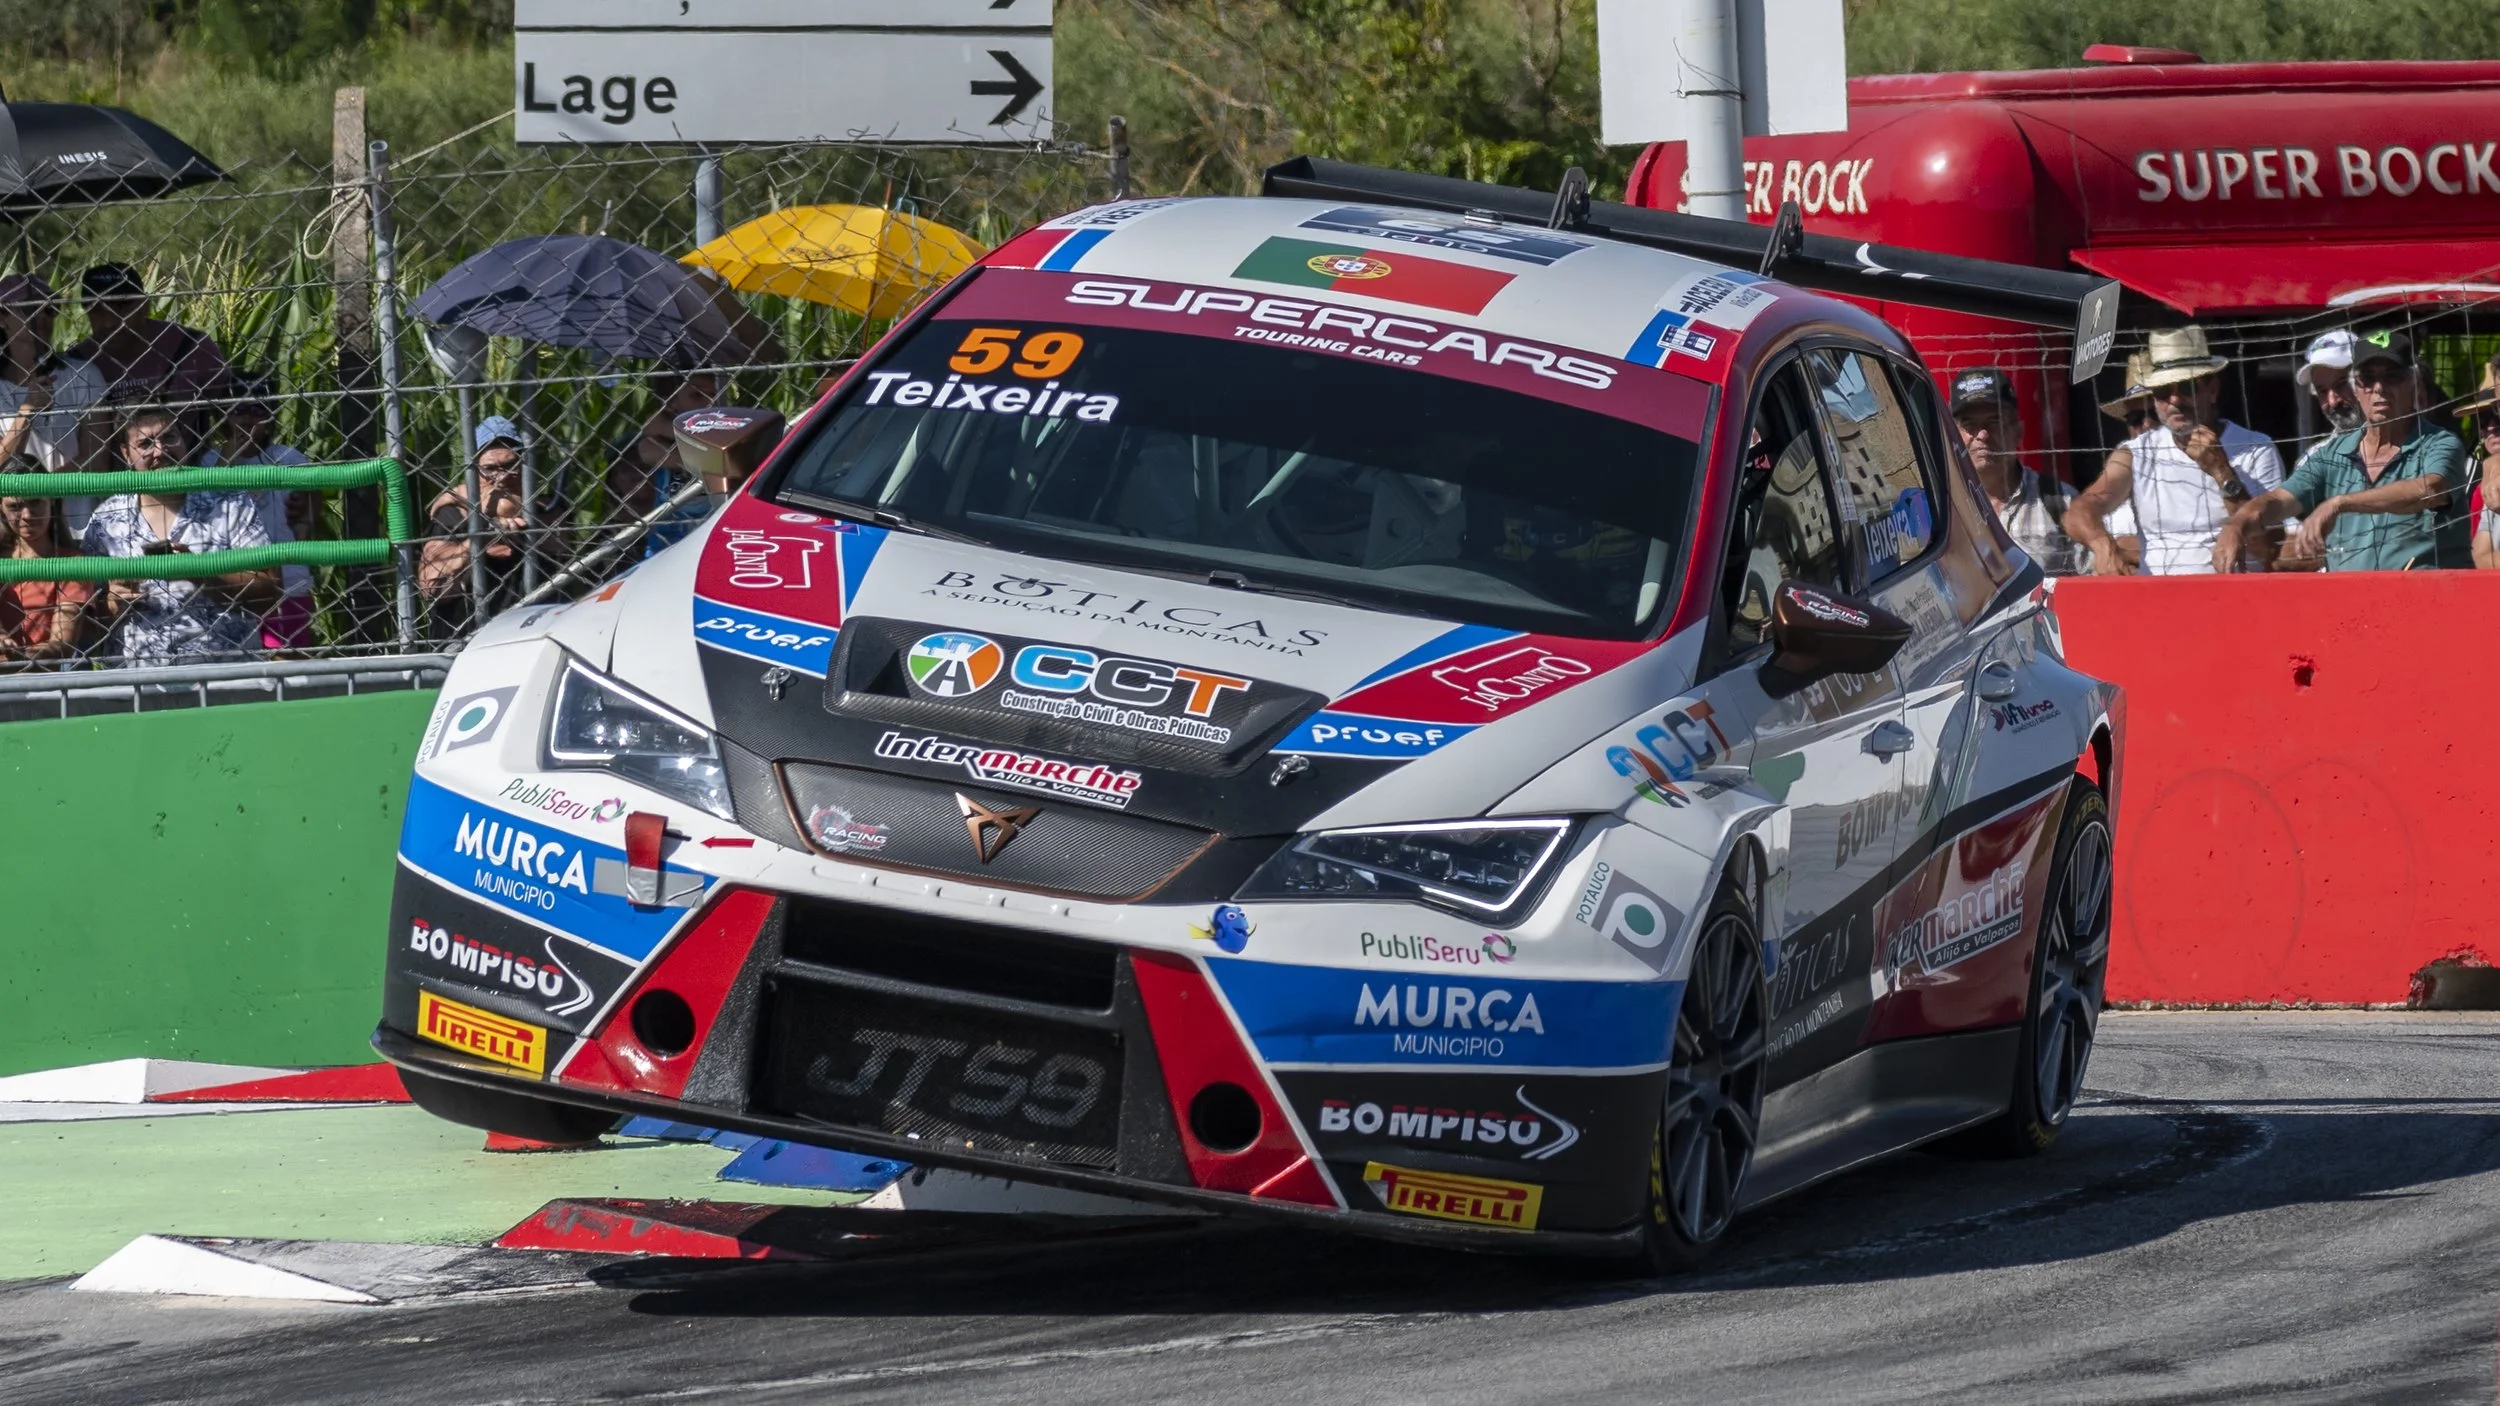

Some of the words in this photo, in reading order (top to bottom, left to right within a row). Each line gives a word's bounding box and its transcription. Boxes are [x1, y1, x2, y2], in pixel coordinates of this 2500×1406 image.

[524, 62, 677, 124] Lage
[58, 150, 107, 164] INESIS
[2136, 151, 2324, 202] SUPER
[2338, 142, 2500, 198] BOCK
[1783, 158, 1873, 216] BOCK
[947, 328, 1085, 379] 59
[1064, 280, 1618, 390] SUPERCARS
[1233, 325, 1348, 353] TOURING
[1351, 343, 1423, 367] CARS
[864, 370, 1121, 425] Teixeira
[1089, 612, 1128, 626] DA
[1135, 620, 1305, 658] MONTANHA
[1011, 645, 1254, 717] CCT
[1000, 690, 1081, 719] Construção
[1082, 699, 1115, 728] Civil
[1126, 712, 1168, 734] Obras
[1169, 713, 1232, 745] Públicas
[1636, 699, 1732, 782] CCT
[823, 827, 888, 844] RACING
[1575, 861, 1612, 924] POTAUCO
[1934, 945, 1961, 965] Alijó
[1973, 919, 2020, 948] Valpaços
[427, 998, 535, 1065] PIRELLI
[1380, 1170, 1528, 1222] PIRELLI
